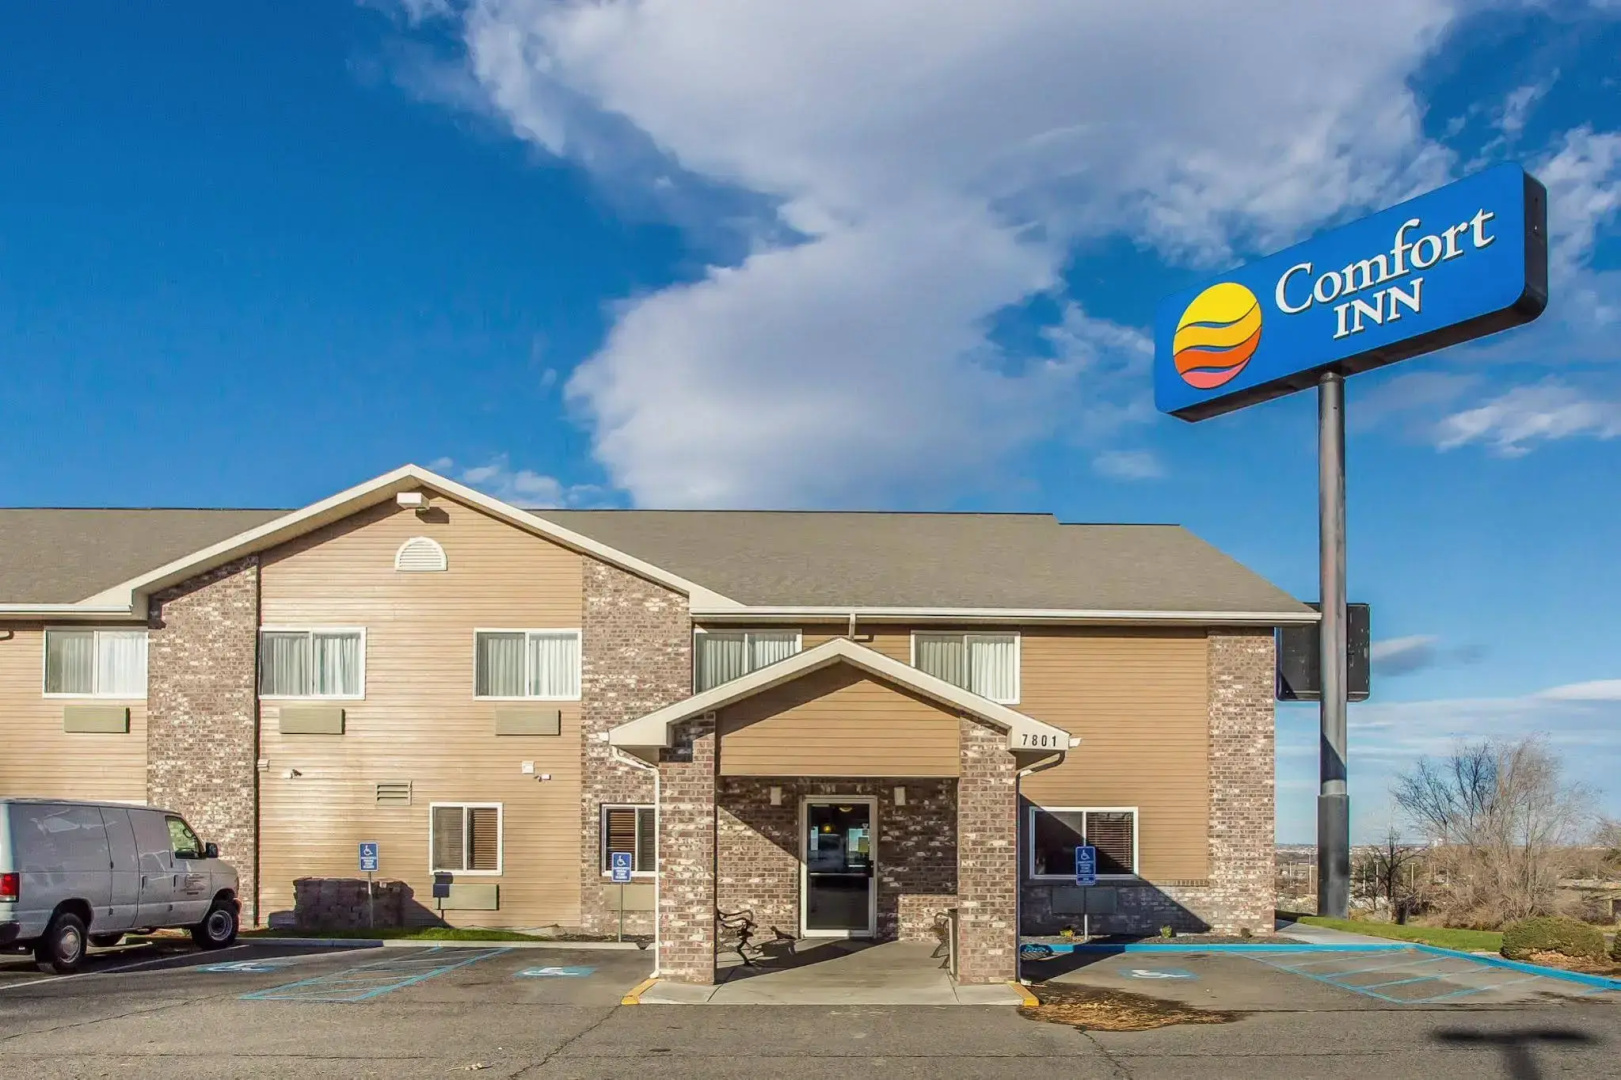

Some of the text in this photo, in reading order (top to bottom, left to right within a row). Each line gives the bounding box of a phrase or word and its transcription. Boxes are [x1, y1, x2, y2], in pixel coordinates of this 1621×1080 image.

[1275, 208, 1496, 314] Comfort
[1333, 277, 1424, 340] INN
[1022, 733, 1057, 747] 7801
